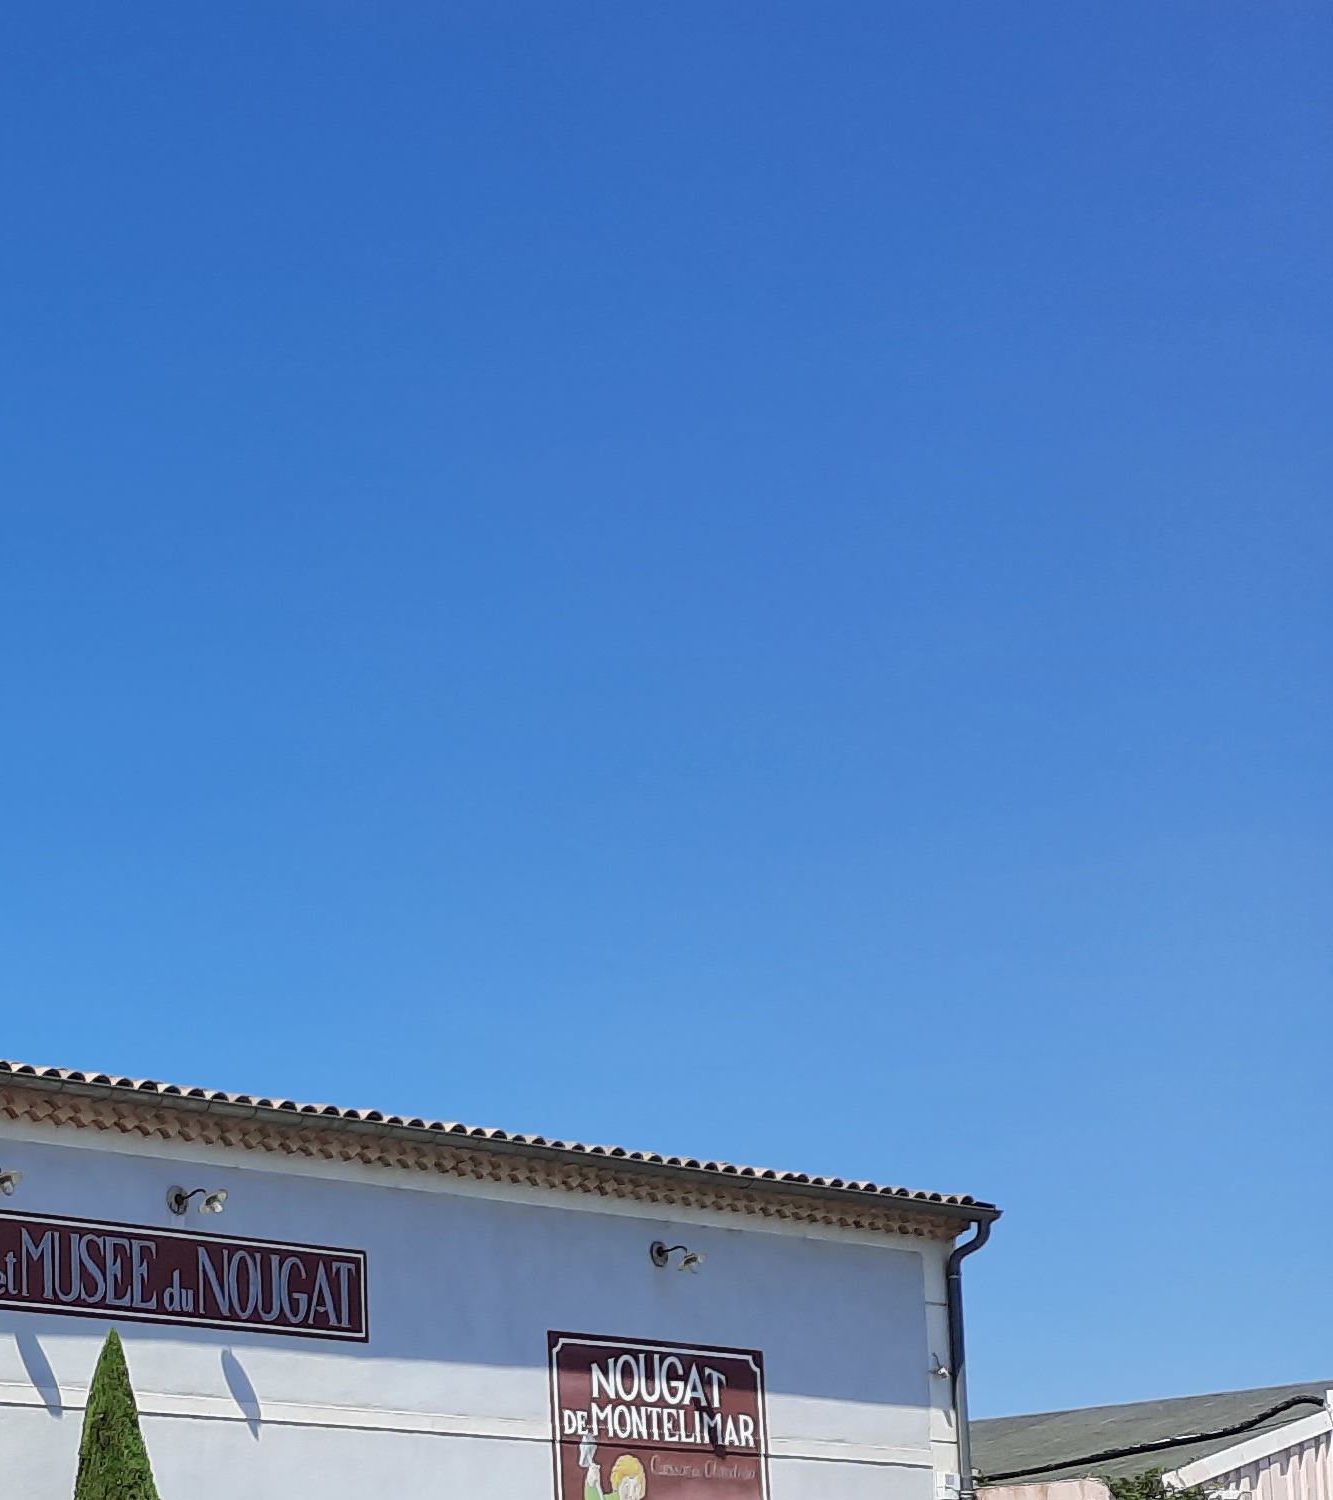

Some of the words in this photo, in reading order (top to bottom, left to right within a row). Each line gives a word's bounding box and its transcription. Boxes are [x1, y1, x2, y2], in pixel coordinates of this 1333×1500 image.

[20, 1227, 159, 1310] MUSEE
[164, 1284, 194, 1314] du
[197, 1245, 357, 1328] NOUGAT
[590, 1353, 727, 1408] NOUGAT
[563, 1409, 589, 1435] DE
[591, 1402, 756, 1448] MONTELIMAR
